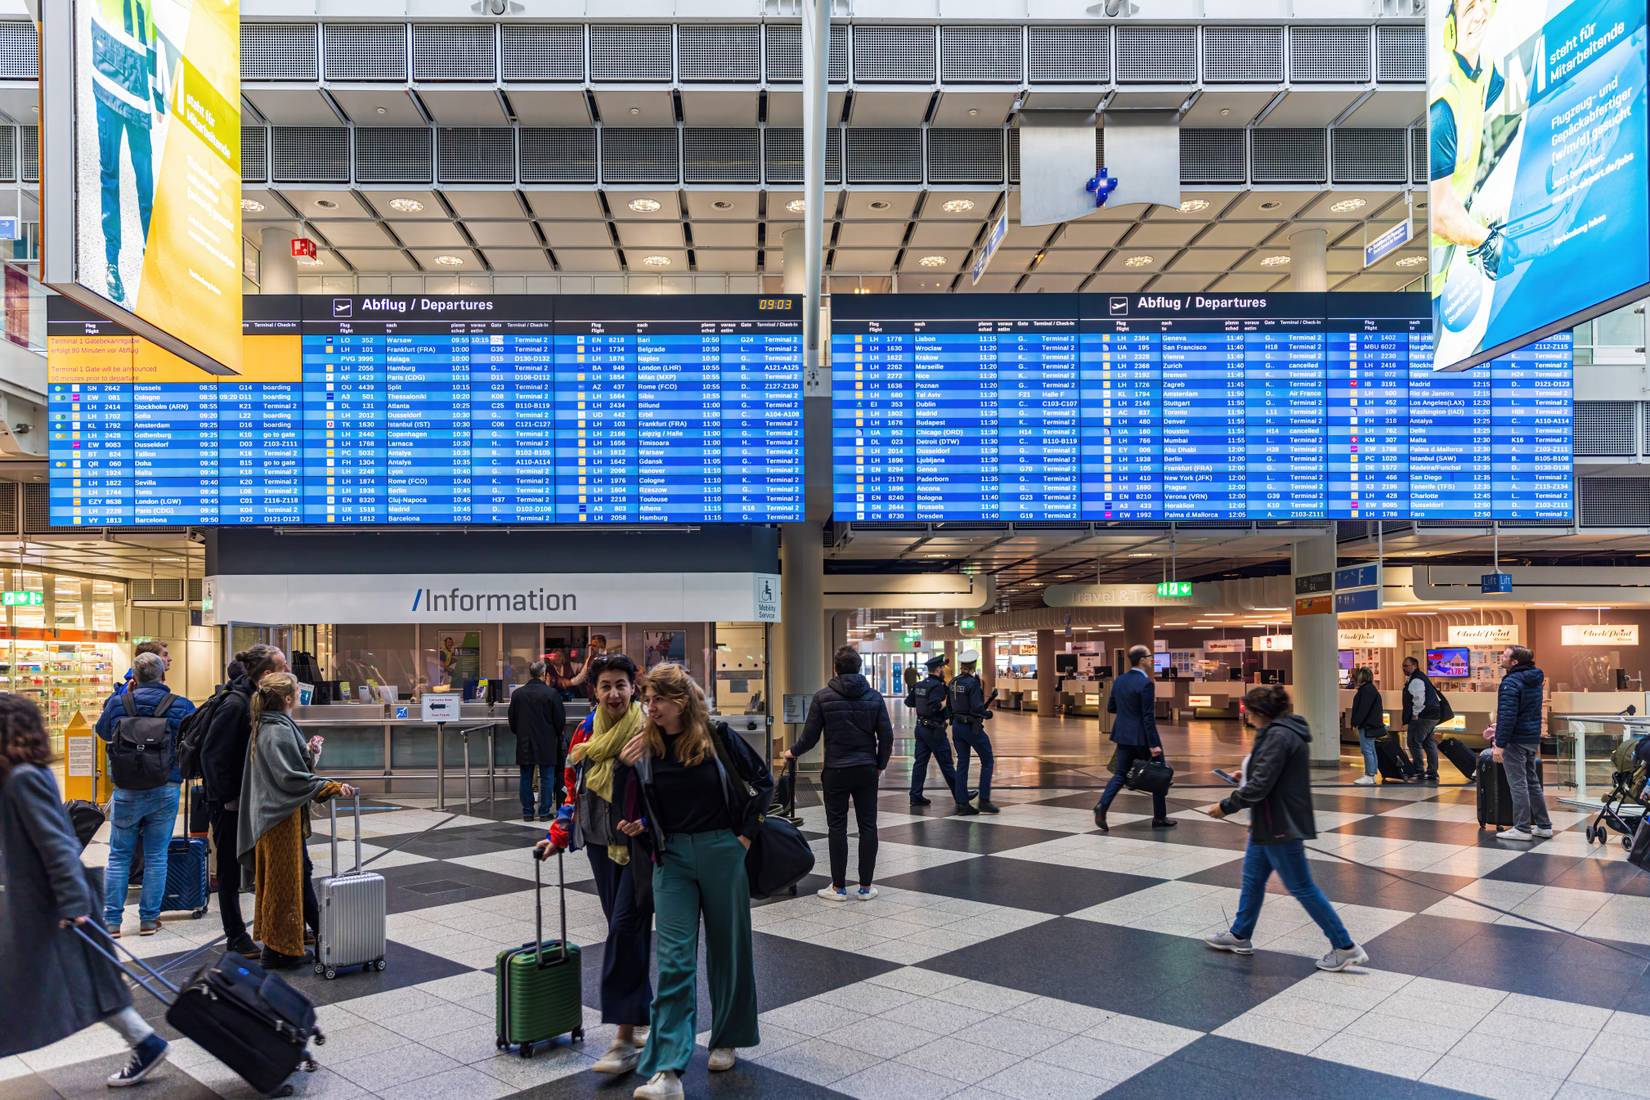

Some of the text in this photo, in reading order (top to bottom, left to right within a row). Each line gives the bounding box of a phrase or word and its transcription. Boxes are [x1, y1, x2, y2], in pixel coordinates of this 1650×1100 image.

[1549, 22, 1597, 65] steht für
[1550, 21, 1625, 84] Mitarbeitende
[1551, 76, 1618, 130] Flugzeug- und
[1551, 86, 1632, 146] Gepäckabfertiger
[1593, 106, 1632, 141] gesucht
[362, 299, 493, 312] Abflug / Departures
[759, 299, 792, 310] 09:03
[1138, 297, 1266, 310] Abflug / Departures
[387, 496, 427, 504] Cluj-Napoca
[1358, 569, 1364, 585] F
[1483, 575, 1497, 585] Lift
[1500, 576, 1511, 585] Lift
